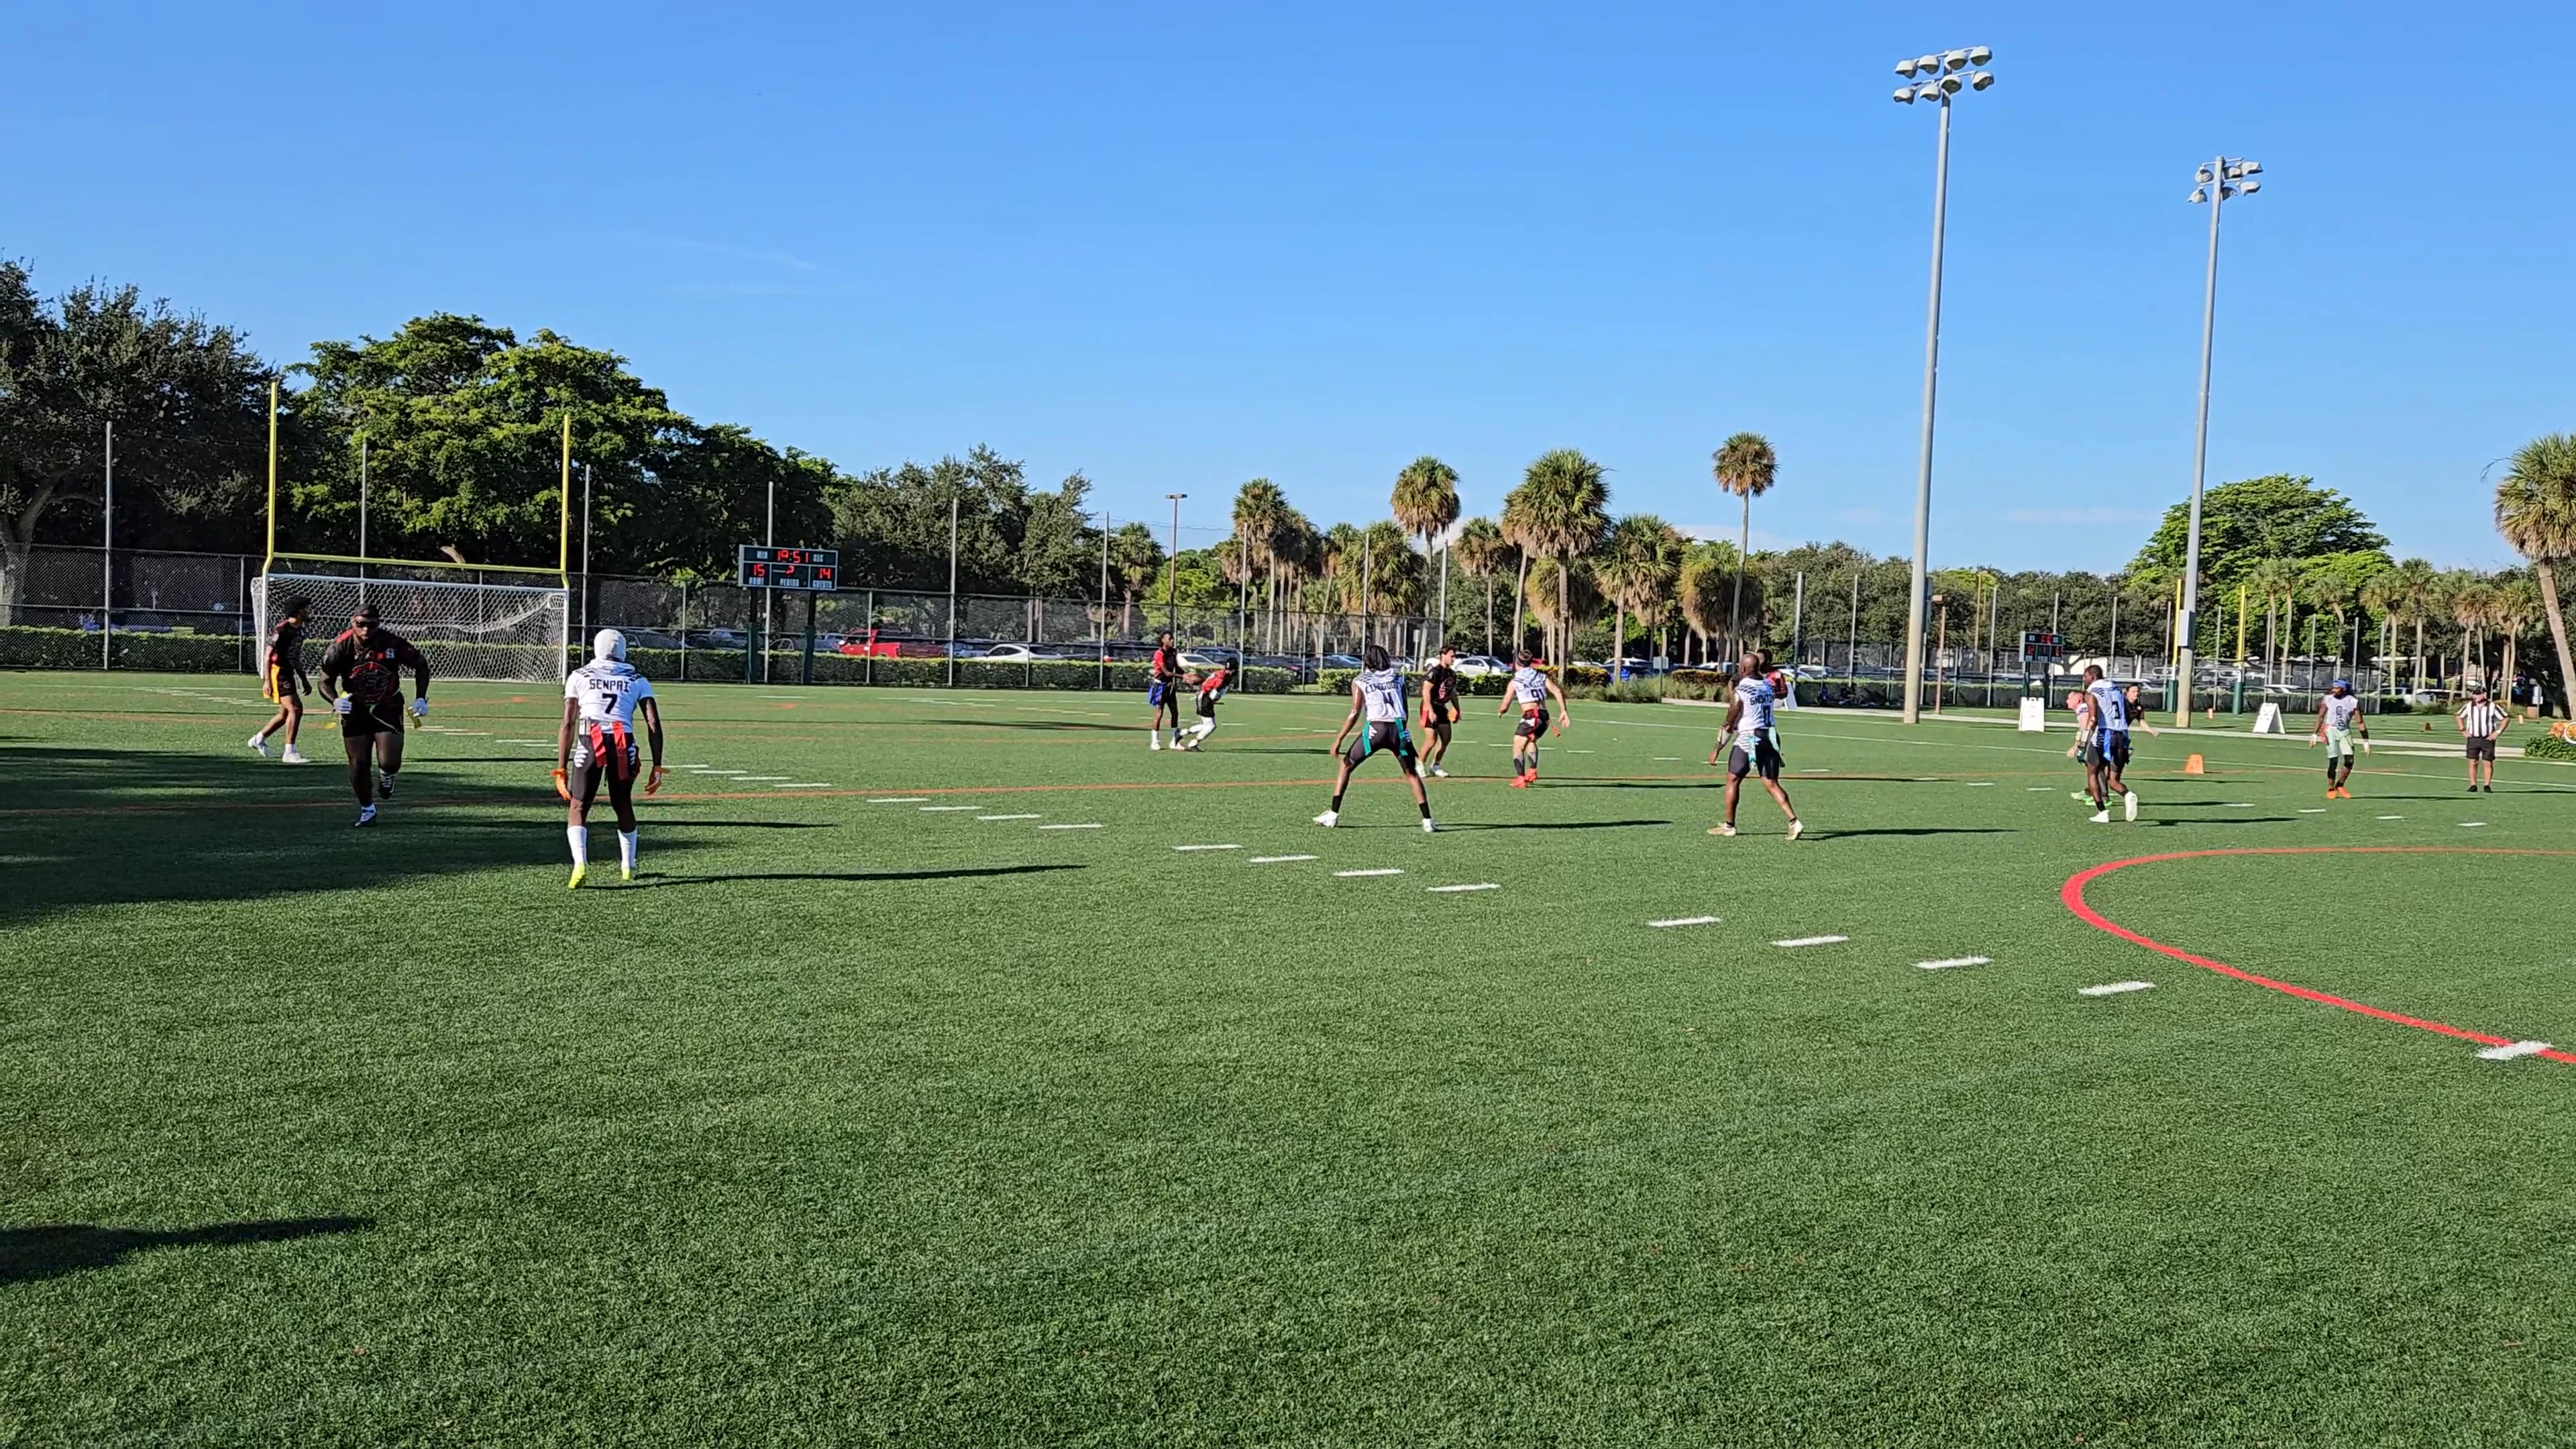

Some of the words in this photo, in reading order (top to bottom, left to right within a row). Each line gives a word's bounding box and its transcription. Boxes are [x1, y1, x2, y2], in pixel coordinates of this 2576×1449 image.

[753, 564, 765, 577] 15
[820, 568, 831, 580] 14
[589, 679, 630, 692] SENPAI
[1530, 689, 1545, 702] 91
[602, 692, 618, 714] 7
